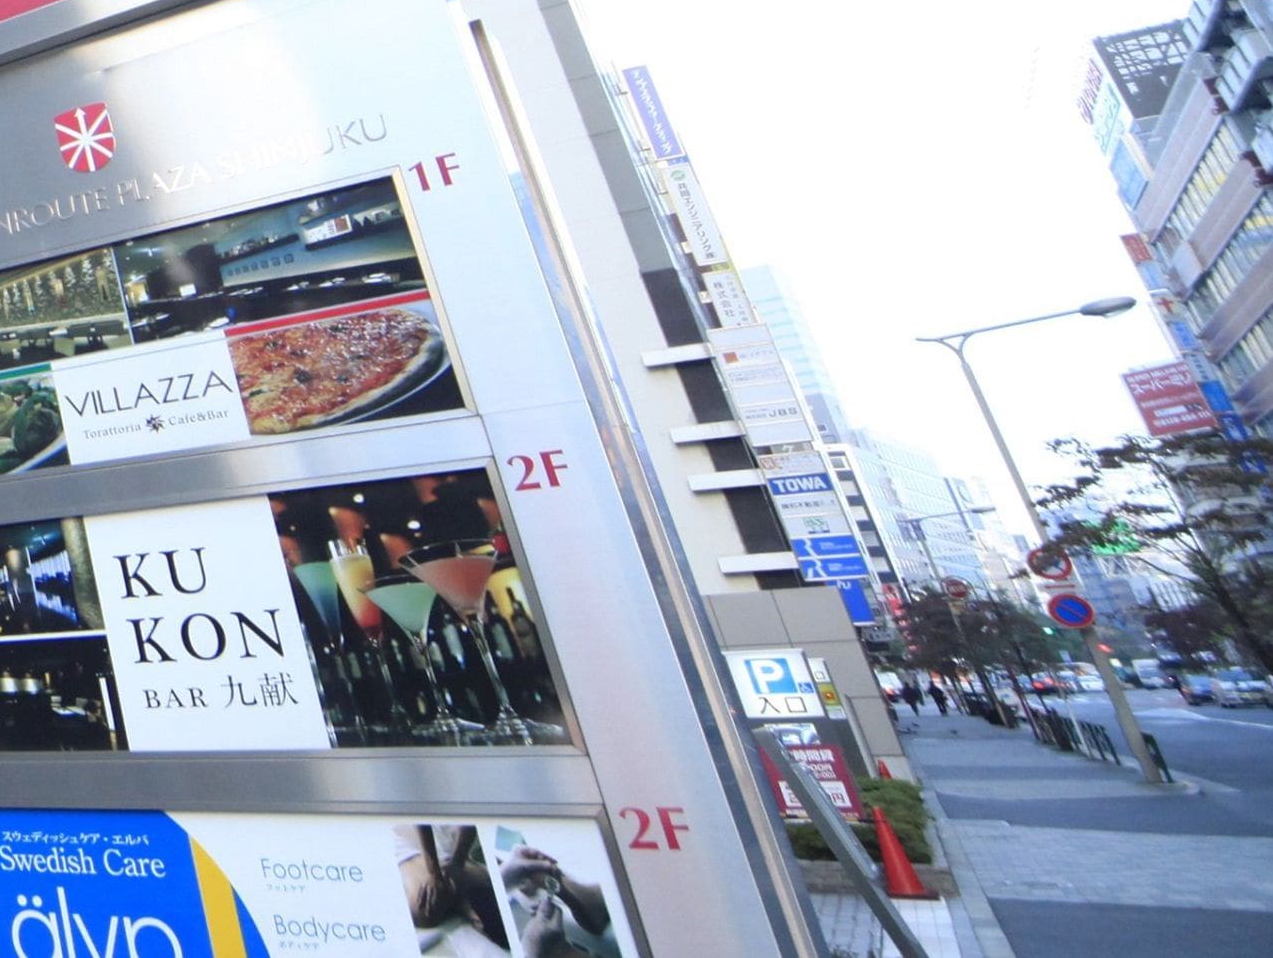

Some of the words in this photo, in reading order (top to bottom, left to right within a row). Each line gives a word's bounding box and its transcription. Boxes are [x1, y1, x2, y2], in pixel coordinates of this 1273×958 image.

[117, 164, 212, 207] PLAZA
[409, 153, 460, 192] 1F
[64, 370, 234, 417] VILLAZZA
[507, 449, 568, 492] 2F
[773, 477, 827, 493] TOWA
[114, 547, 210, 601] KU
[126, 608, 288, 666] KON
[144, 684, 210, 711] BAR
[221, 674, 300, 711] 九献
[749, 659, 785, 694] P
[758, 696, 808, 714] 入口
[617, 806, 692, 852] 2F
[103, 848, 167, 878] Care
[260, 857, 364, 883] Footcare
[273, 914, 387, 943] Bodycare
